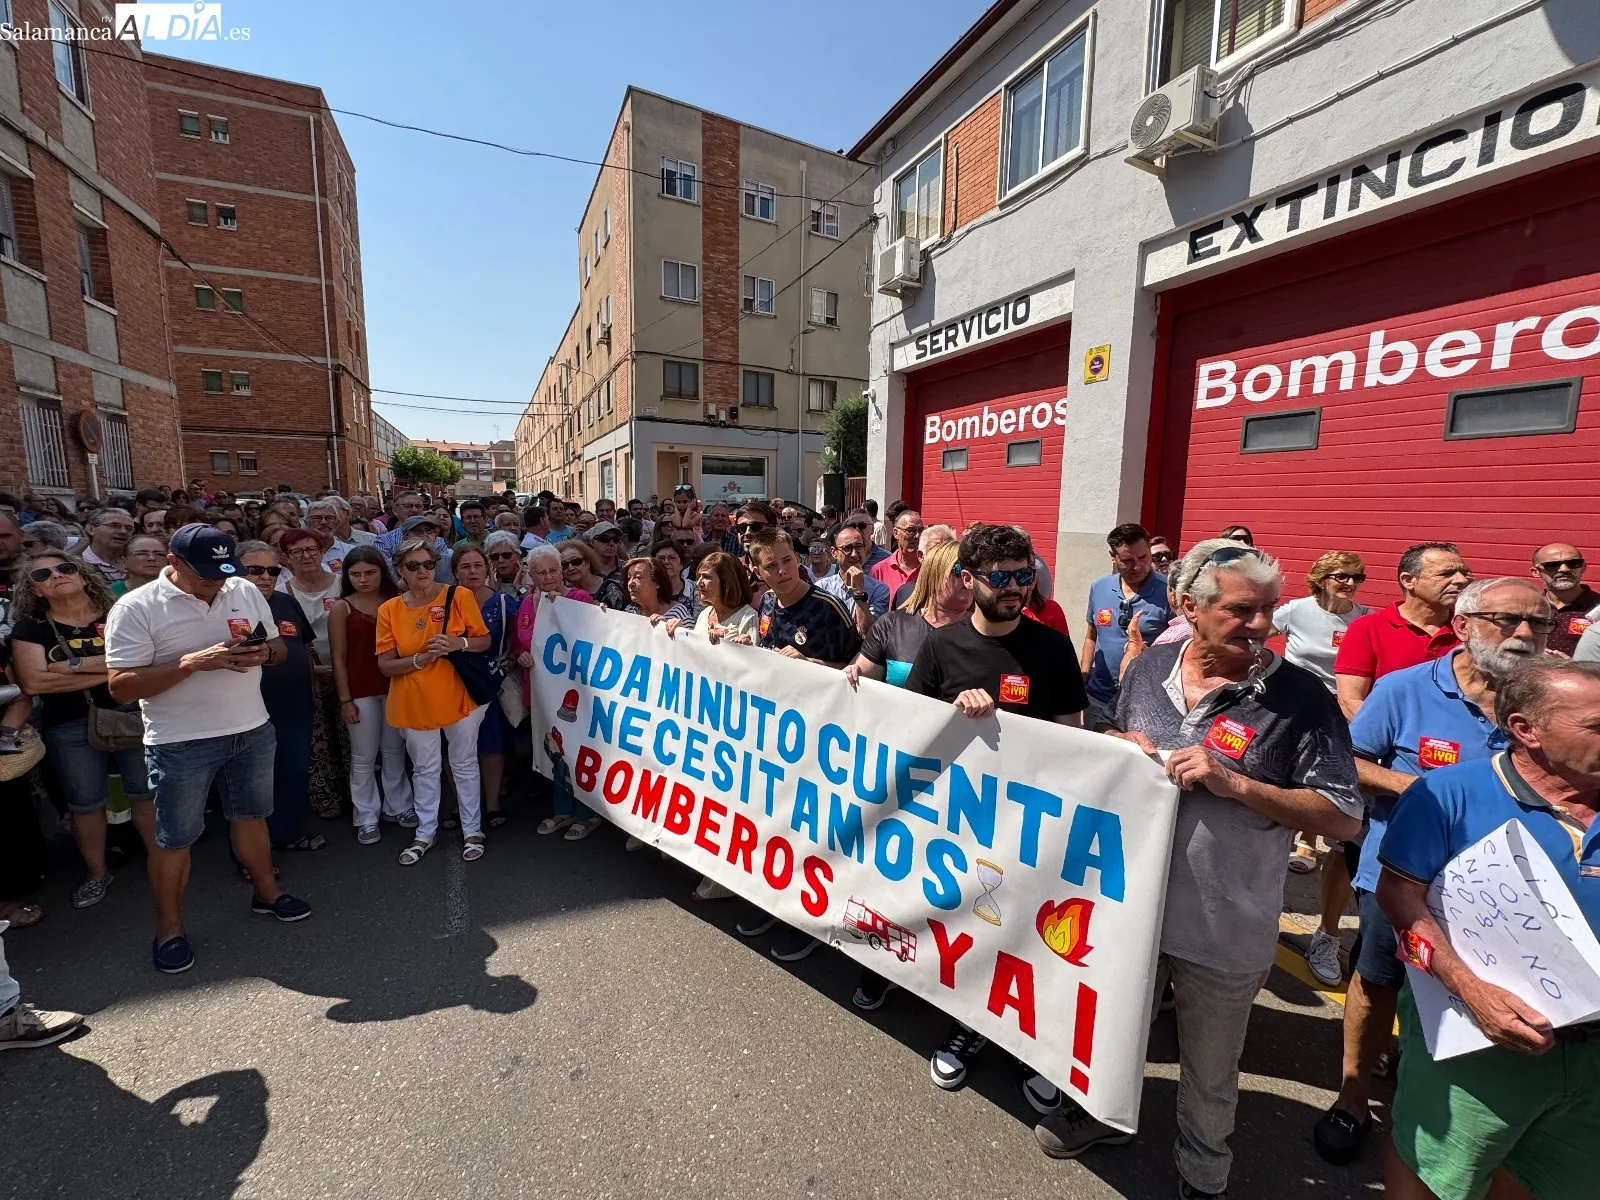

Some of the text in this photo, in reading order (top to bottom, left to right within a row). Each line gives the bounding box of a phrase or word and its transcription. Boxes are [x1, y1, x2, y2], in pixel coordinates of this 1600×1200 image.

[1187, 82, 1600, 265] EXTINCIO
[915, 294, 1031, 361] SERVICIO
[543, 633, 1125, 903] CADA MINUTO CUENTA
[575, 745, 833, 917] BOMBEROS
[588, 695, 968, 911] NECESITAMOS
